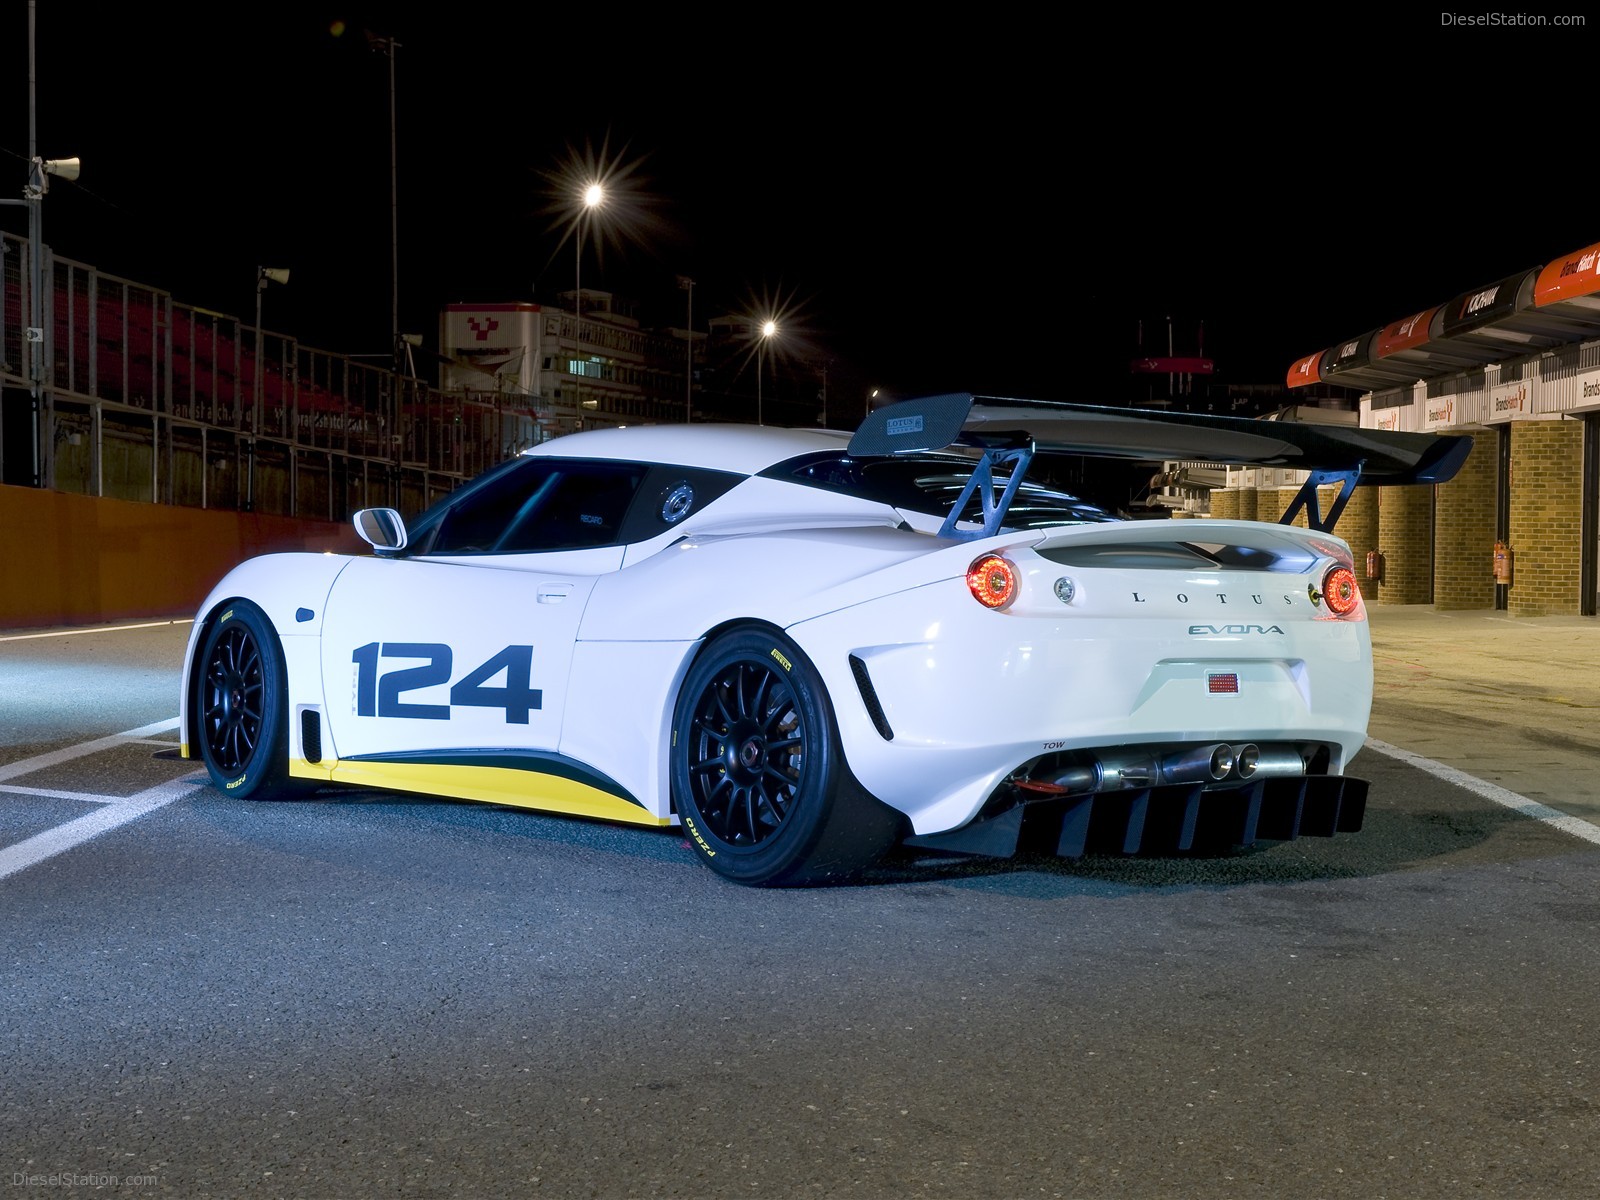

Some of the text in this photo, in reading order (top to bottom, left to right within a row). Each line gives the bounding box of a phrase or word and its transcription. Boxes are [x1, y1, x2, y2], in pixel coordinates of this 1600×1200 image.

[887, 418, 913, 428] LOTUS
[580, 514, 603, 525] RECARO
[1132, 592, 1292, 605] LOTUS
[1188, 624, 1285, 635] EVORA
[770, 648, 792, 671] PIRELLI
[352, 642, 543, 724] 124
[1043, 741, 1065, 750] TOW
